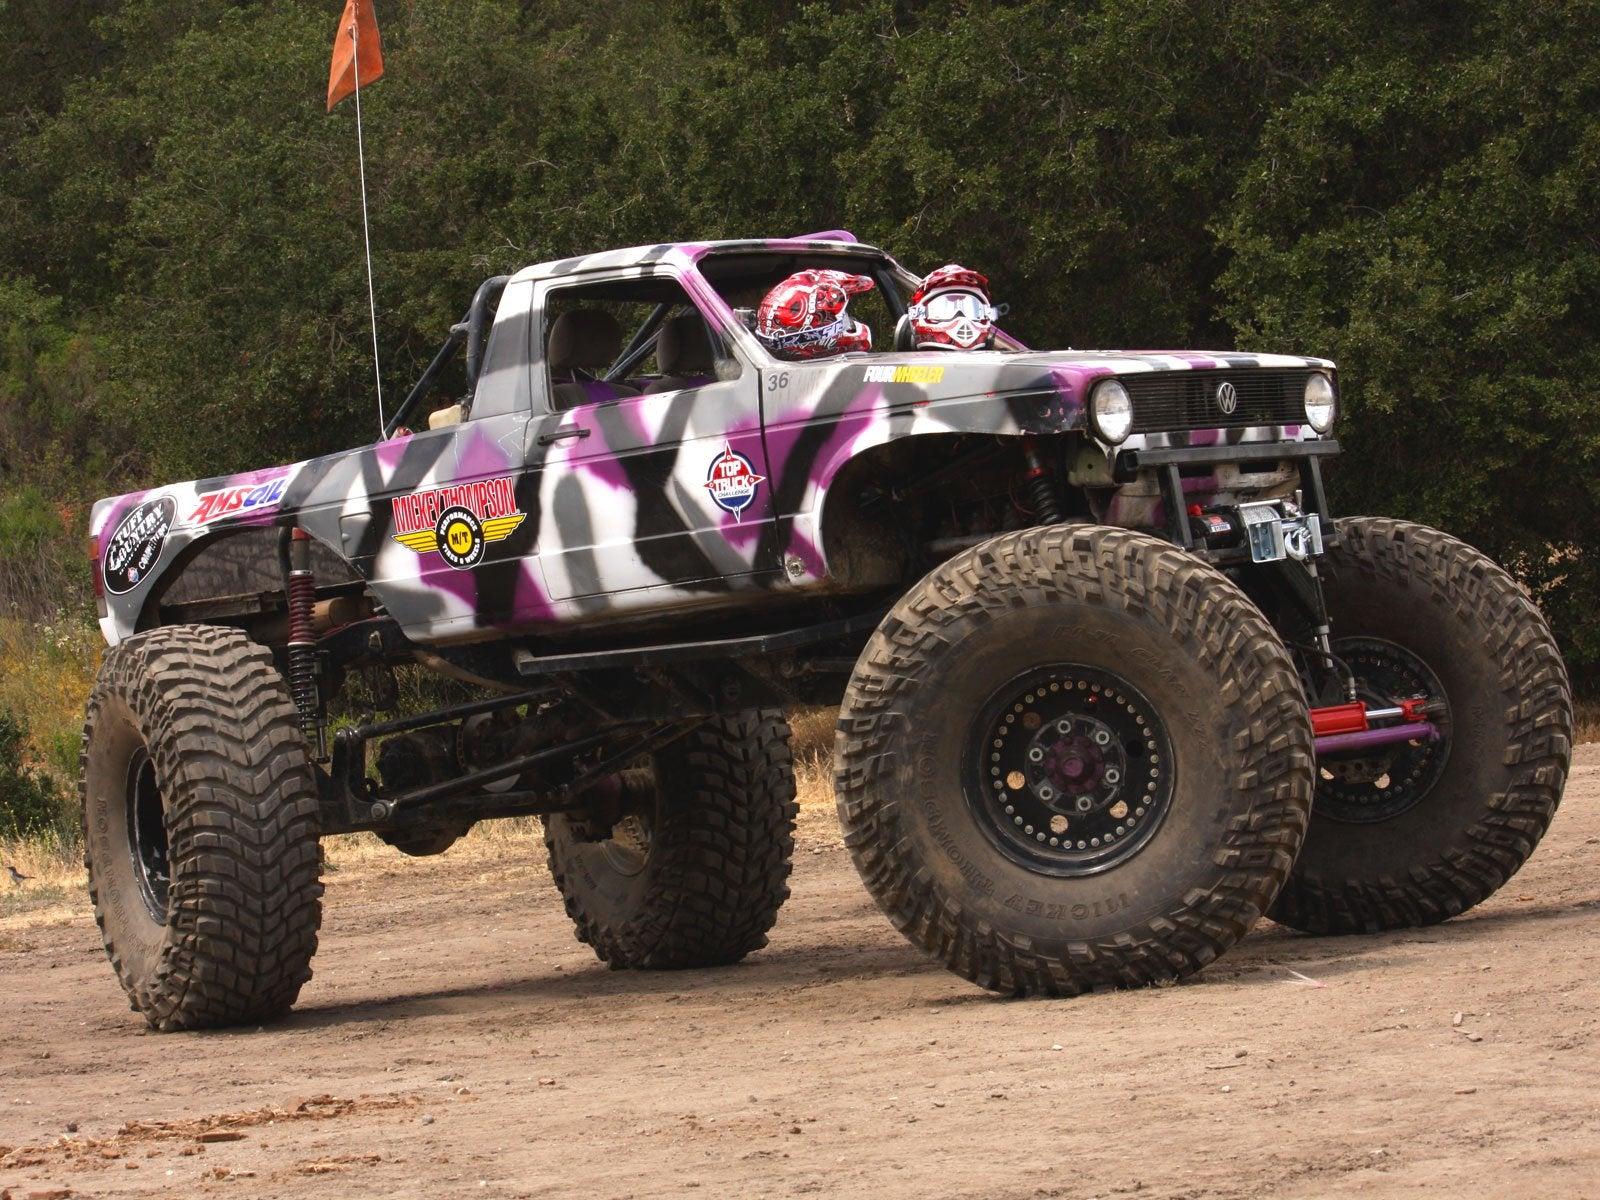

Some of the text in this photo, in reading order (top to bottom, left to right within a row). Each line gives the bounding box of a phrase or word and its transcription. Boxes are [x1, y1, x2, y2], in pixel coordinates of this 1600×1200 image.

[768, 372, 789, 391] 36
[719, 460, 741, 477] TOP
[713, 475, 749, 492] TRUCK
[718, 489, 750, 498] CHALLENGE
[187, 479, 287, 524] AMSOIL
[392, 477, 518, 533] MICKEY THOMPSON
[115, 507, 145, 546] TUFF
[440, 512, 478, 536] PERFORMANCE
[109, 502, 164, 571] COUNTRY
[450, 531, 469, 545] M/T
